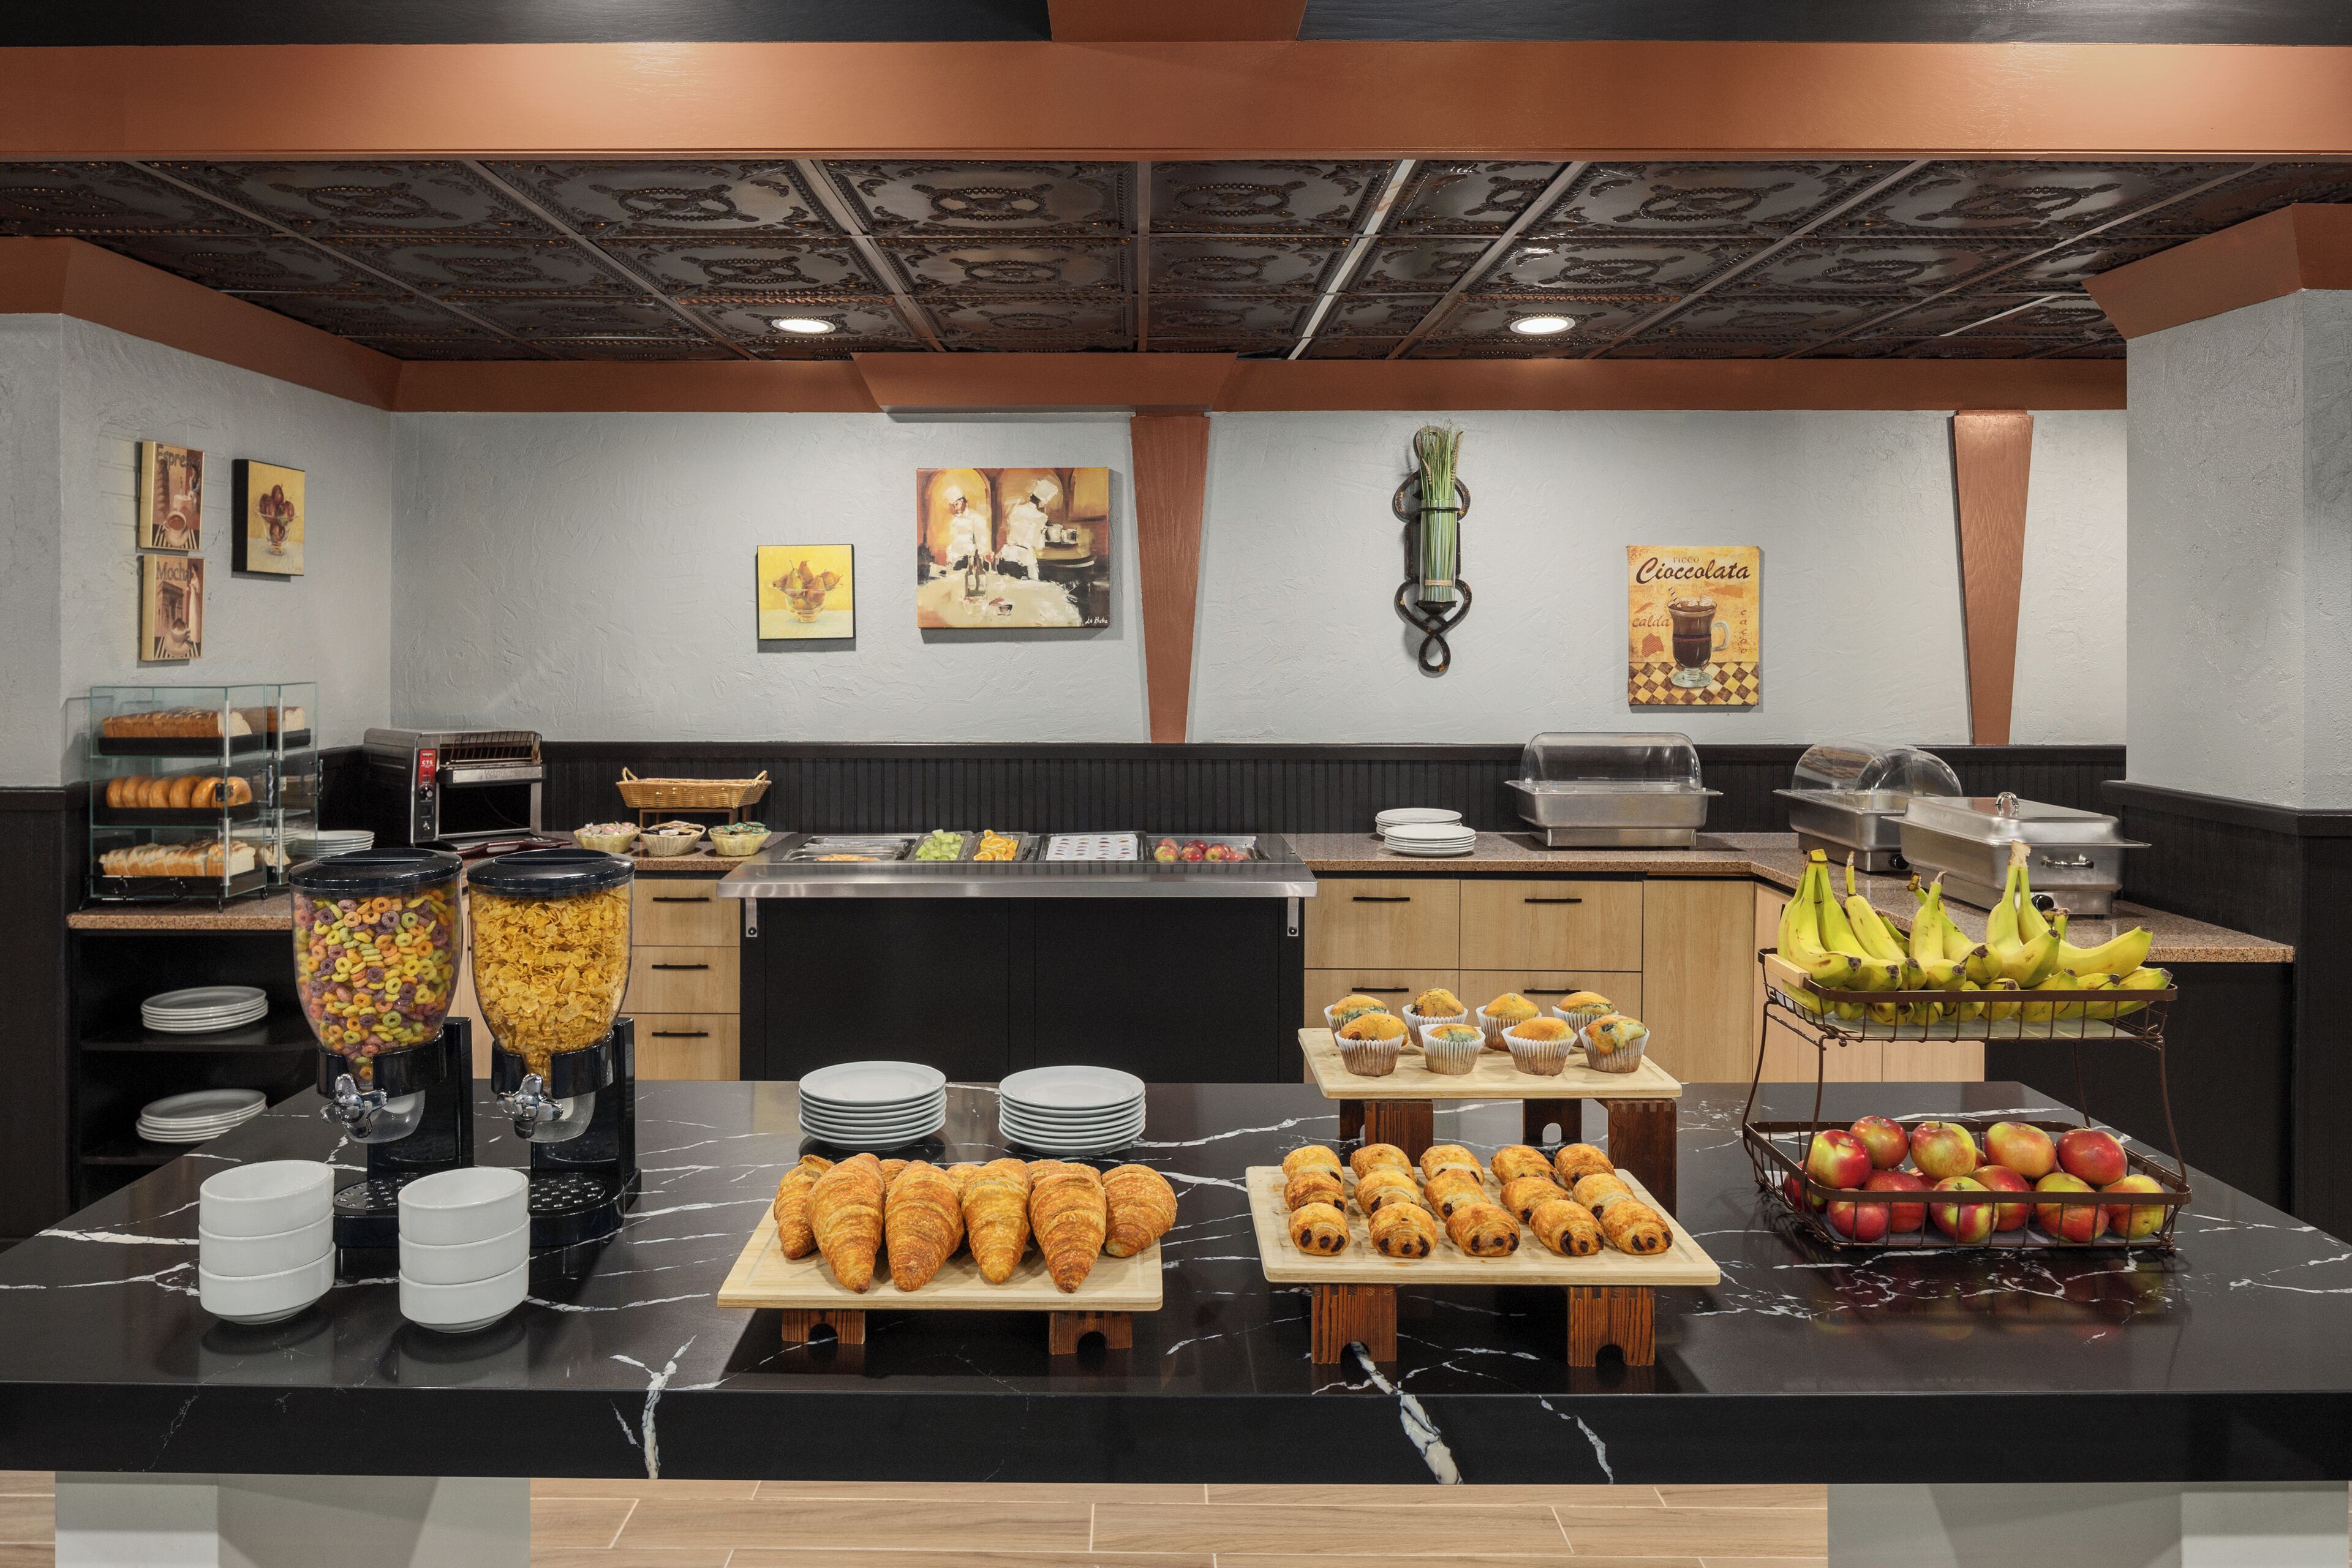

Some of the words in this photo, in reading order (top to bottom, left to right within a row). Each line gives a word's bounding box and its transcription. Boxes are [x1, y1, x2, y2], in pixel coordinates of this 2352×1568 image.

[156, 443, 202, 471] Espresso
[156, 561, 190, 581] Mocha
[1636, 557, 1750, 584] Cioccolata
[1632, 614, 1670, 627] calda
